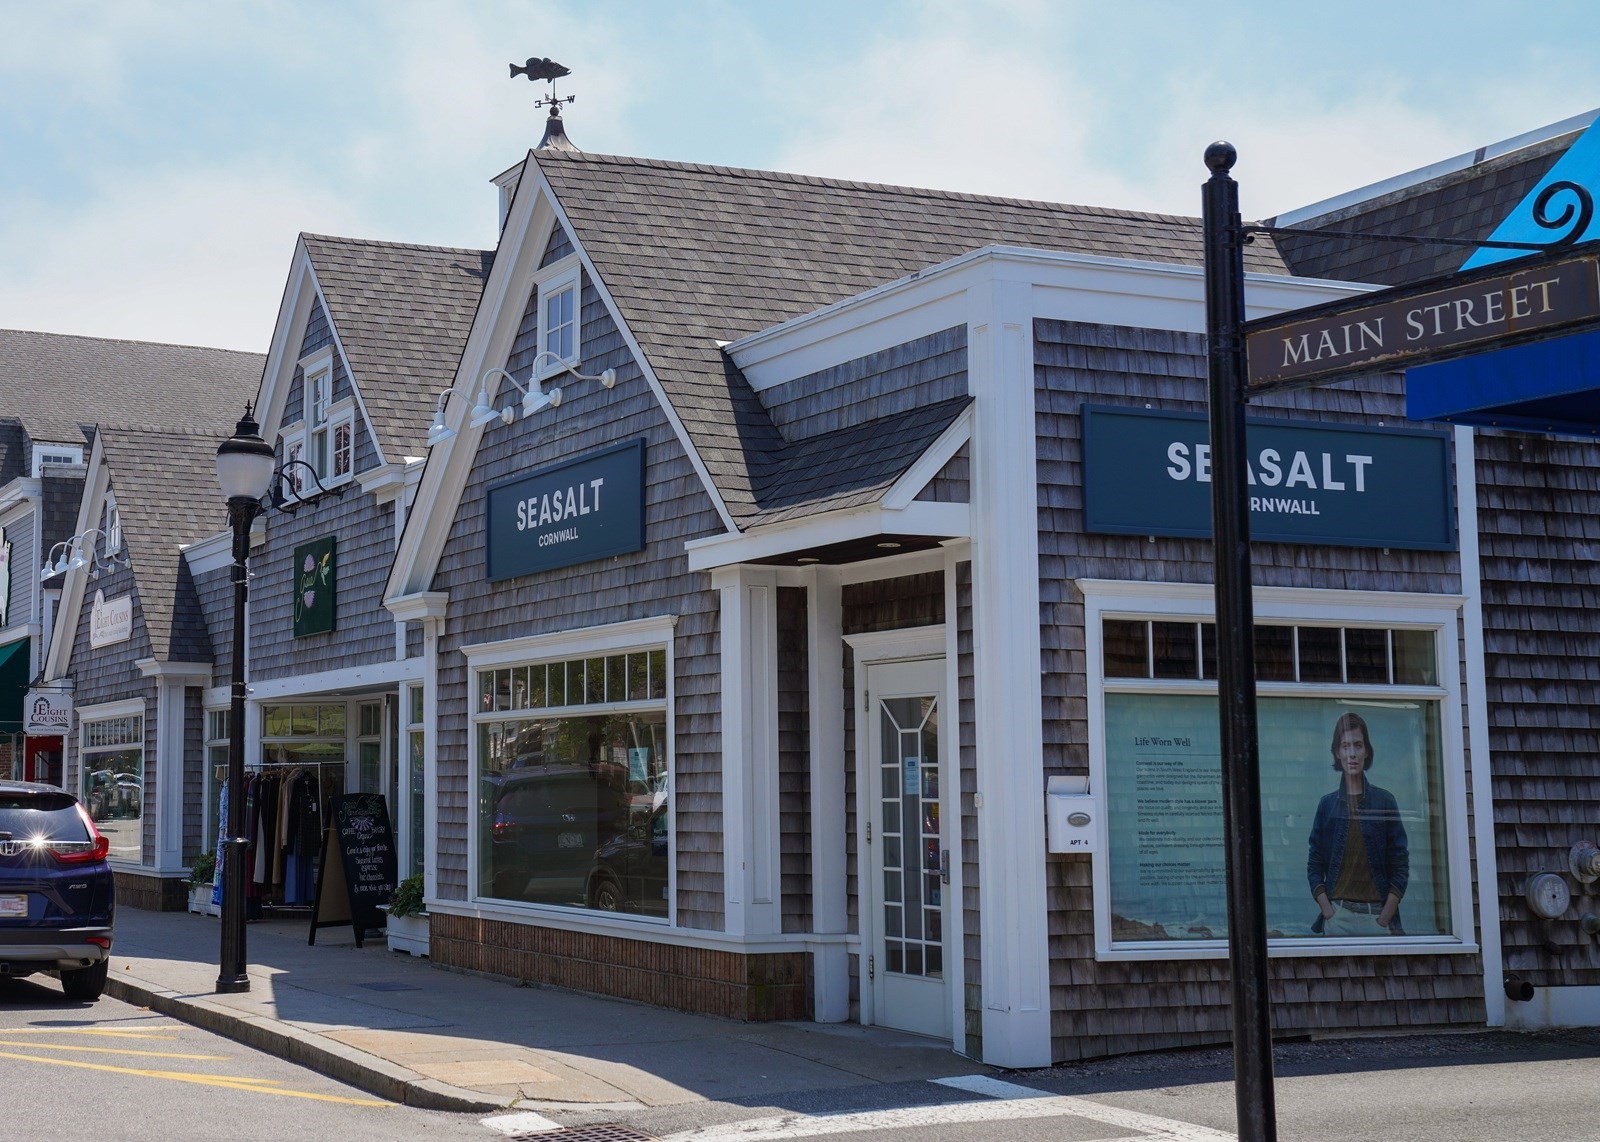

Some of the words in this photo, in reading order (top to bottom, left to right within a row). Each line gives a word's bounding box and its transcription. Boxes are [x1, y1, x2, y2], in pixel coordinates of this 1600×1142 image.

[567, 95, 575, 103] W
[1281, 316, 1384, 367] MAIN
[1406, 277, 1560, 341] STREET
[1167, 442, 1373, 492] SESALT
[517, 478, 603, 531] SEASALT
[539, 527, 578, 547] CORNWALL
[38, 703, 68, 716] EIGHT
[31, 714, 68, 723] COUSINS
[1135, 737, 1150, 746] Life
[1151, 737, 1172, 746] Worn
[1174, 737, 1190, 746] Well
